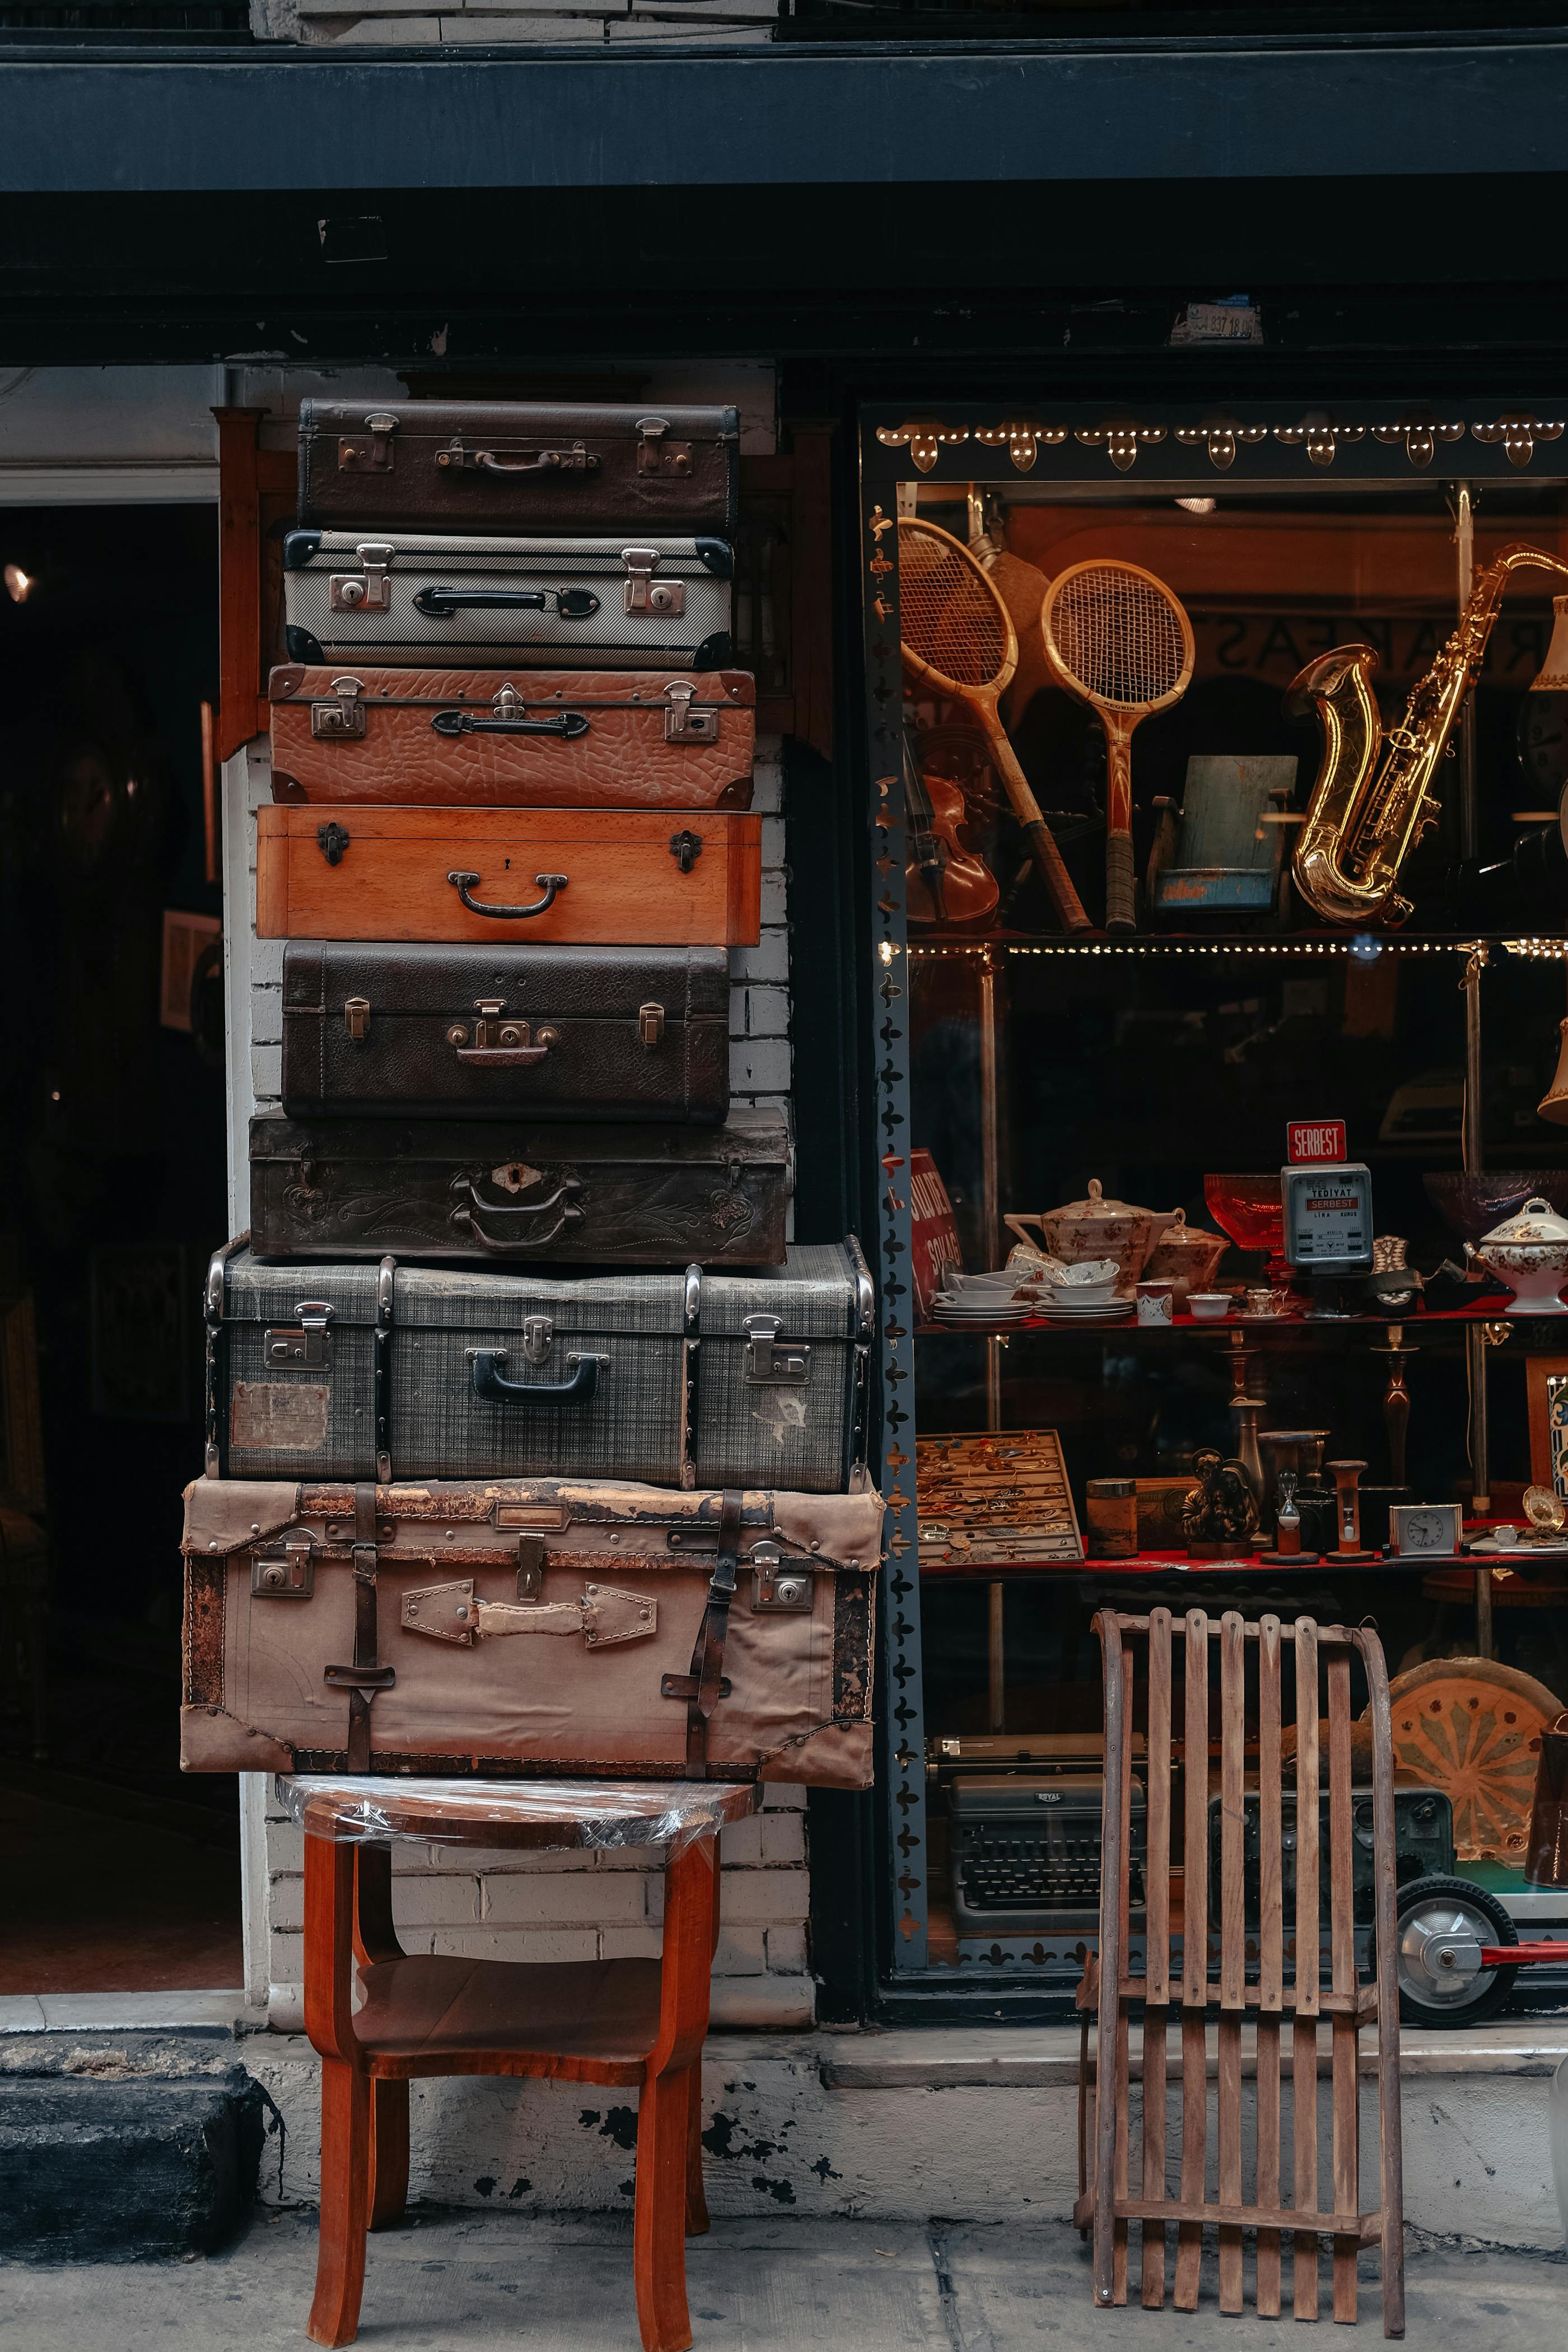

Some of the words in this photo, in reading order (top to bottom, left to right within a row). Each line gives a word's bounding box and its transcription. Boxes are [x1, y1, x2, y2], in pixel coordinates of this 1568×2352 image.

[1211, 316, 1226, 333] 837
[1294, 1127, 1339, 1157] SERBEST
[1312, 1188, 1351, 1197] TEDİYAT
[1312, 1199, 1353, 1208] SERBEST
[1038, 1793, 1061, 1802] ROYAL
